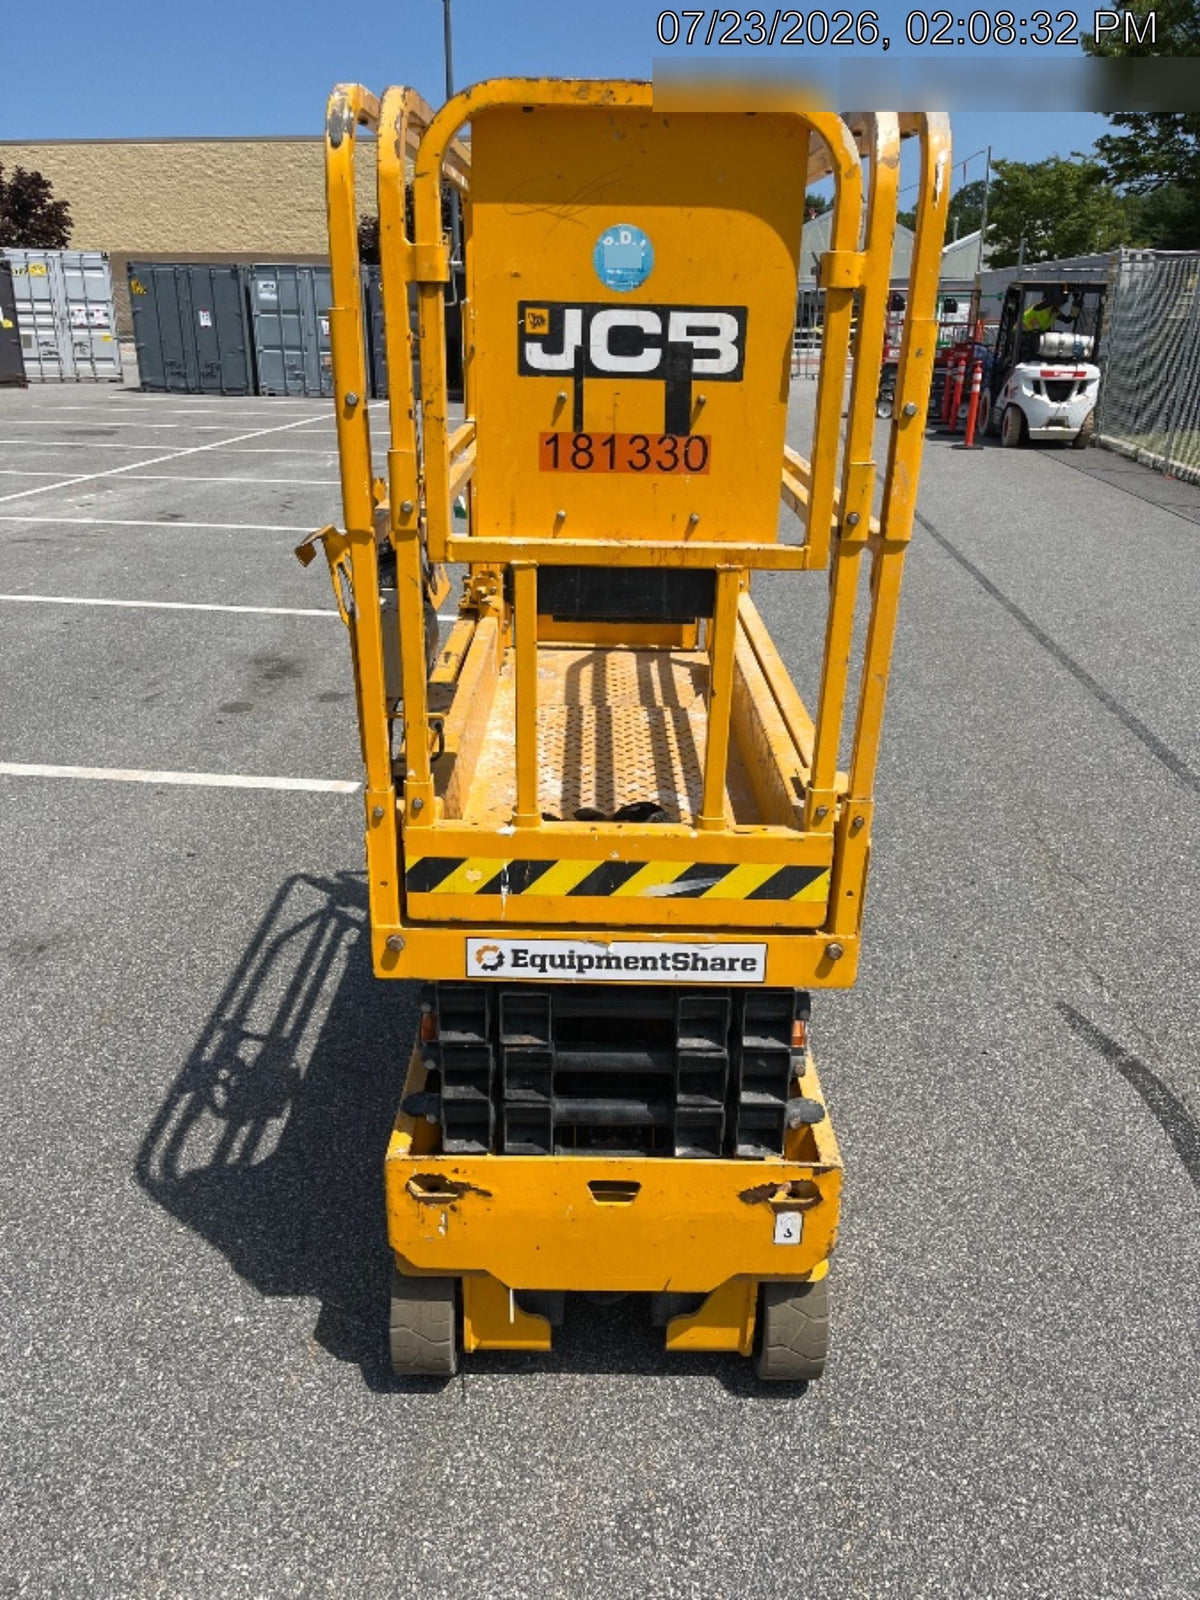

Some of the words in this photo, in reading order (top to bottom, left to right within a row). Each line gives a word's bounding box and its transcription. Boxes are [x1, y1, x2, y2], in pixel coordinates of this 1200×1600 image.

[525, 308, 739, 374] JCB
[544, 433, 709, 472] 181330
[511, 948, 757, 973] EquipmentShare
